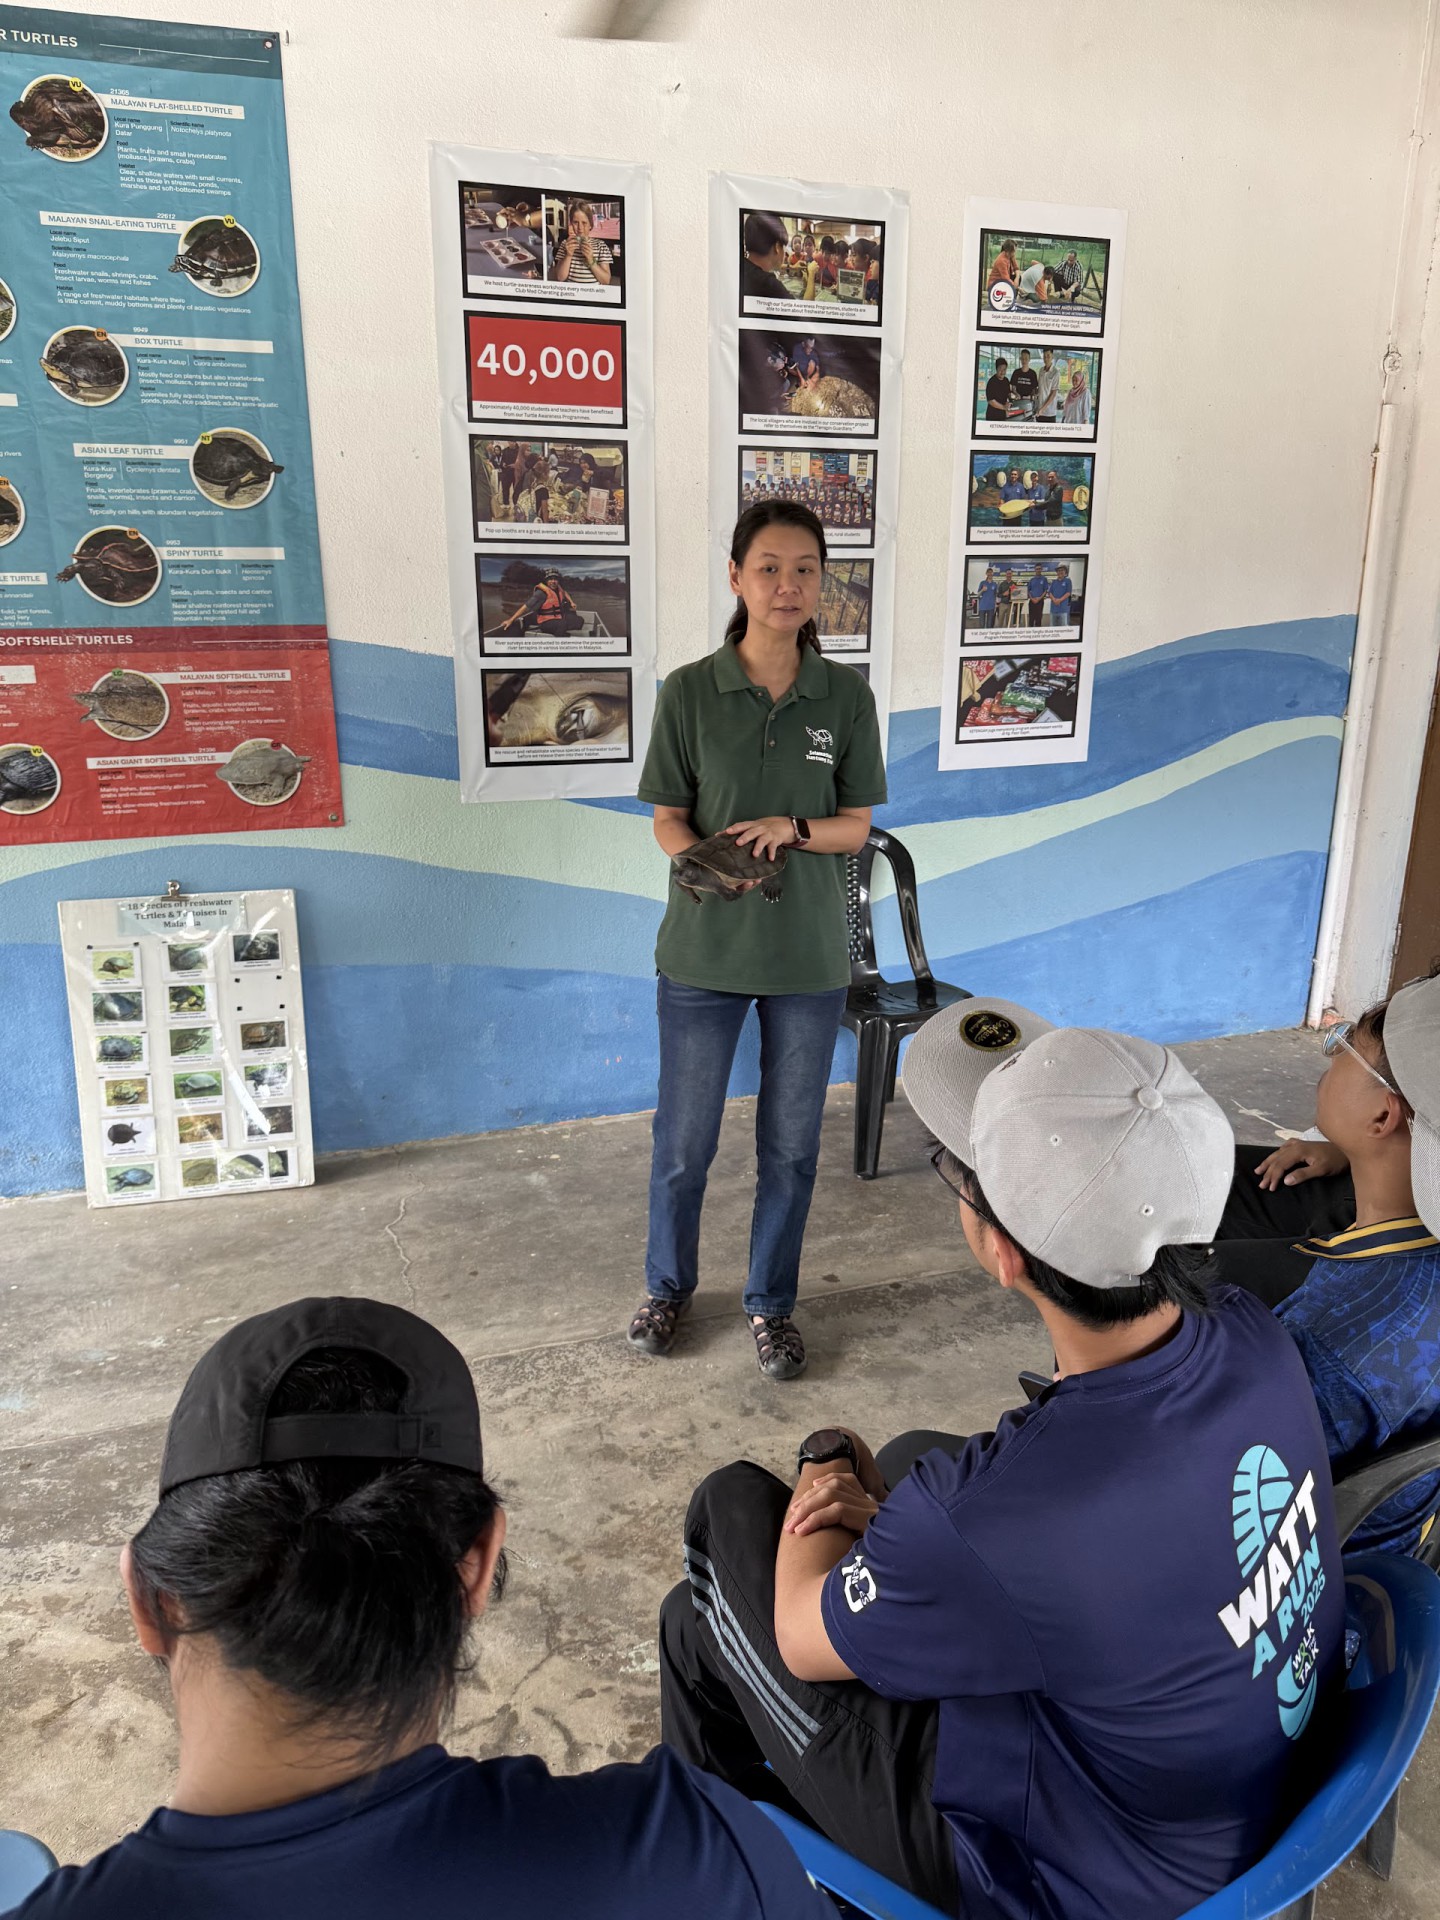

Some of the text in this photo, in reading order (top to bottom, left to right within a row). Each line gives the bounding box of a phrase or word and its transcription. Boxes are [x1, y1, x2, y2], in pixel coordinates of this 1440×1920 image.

[10, 30, 77, 47] TURTLES
[111, 98, 232, 114] MALAYAN FLAT-SHELLED TURTLE
[131, 123, 162, 132] Punggung
[188, 152, 227, 160] invertebrates
[48, 216, 176, 230] MALAYAN SNAIL-EATING TURTLE
[105, 300, 126, 308] muddy
[477, 343, 615, 385] 40,000
[0, 635, 133, 646] SOFTSHELL TURTLES
[1218, 1469, 1317, 1648] WATT
[1301, 1568, 1326, 1628] 2025
[1252, 1533, 1320, 1680] A RUN
